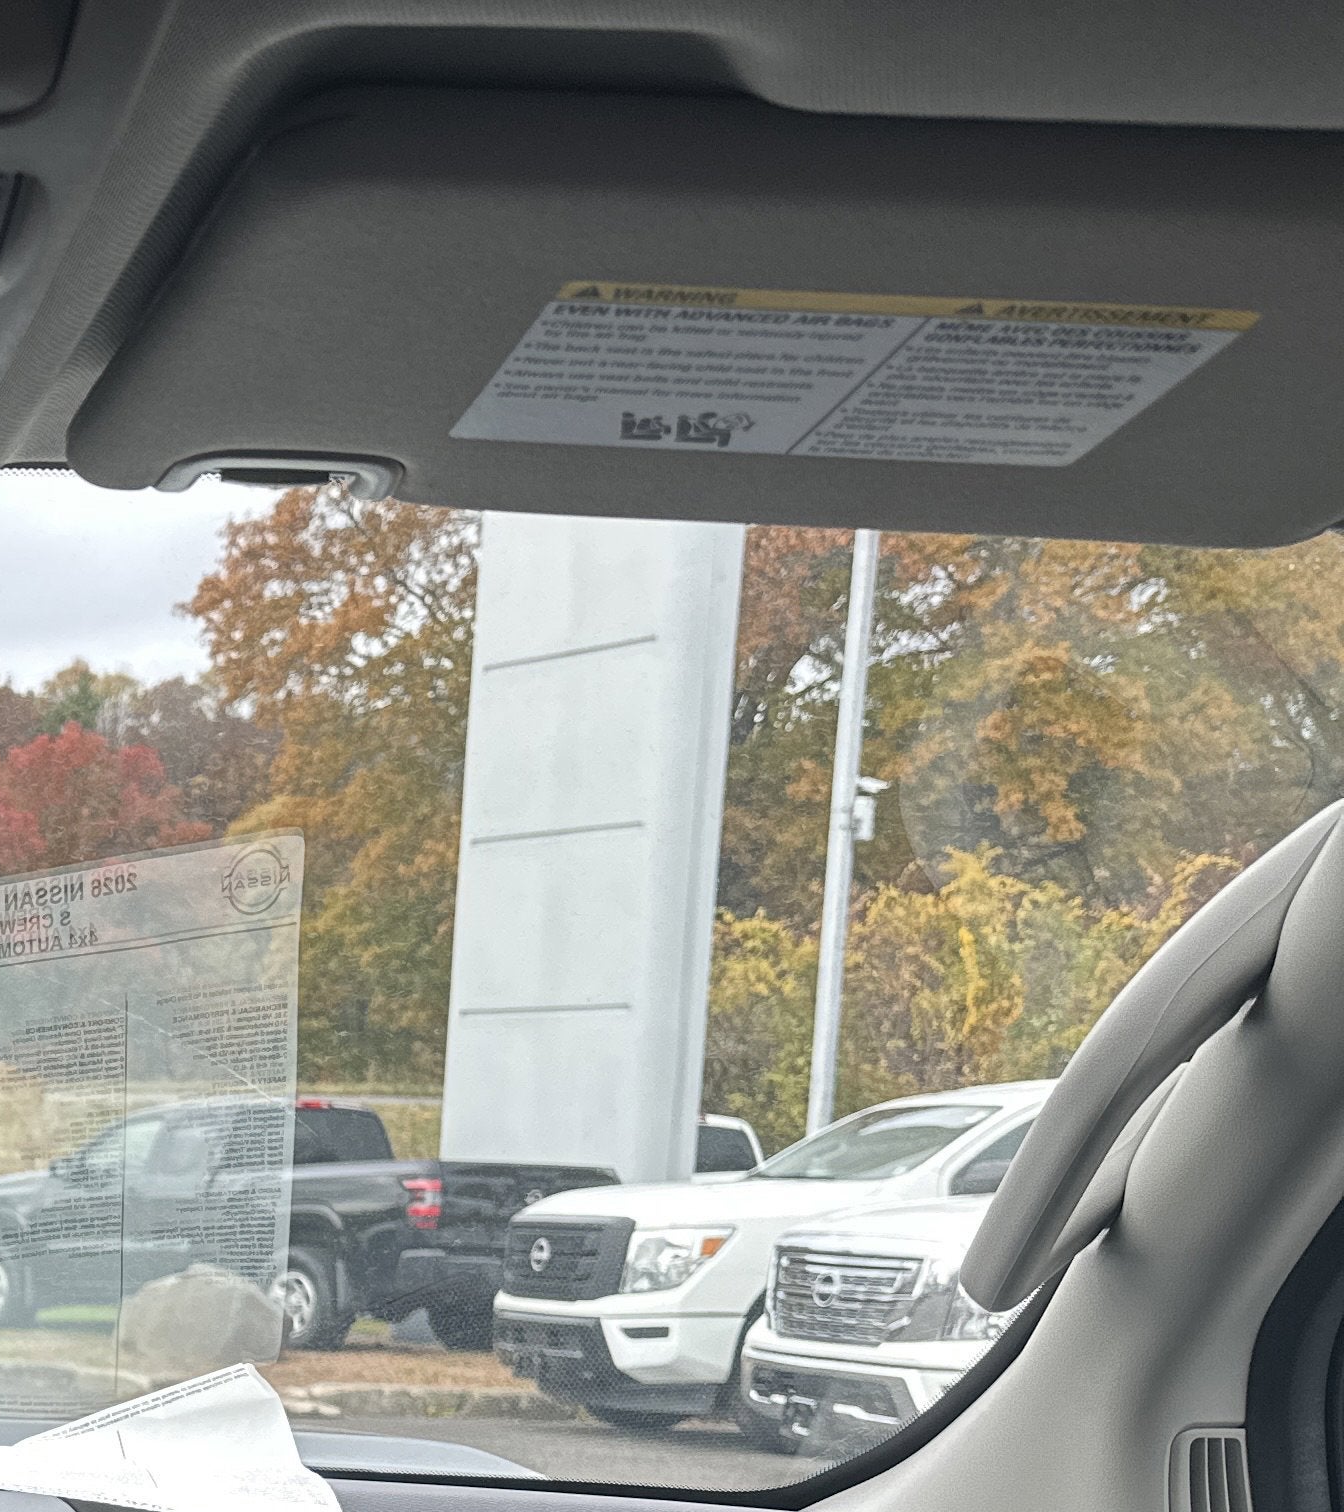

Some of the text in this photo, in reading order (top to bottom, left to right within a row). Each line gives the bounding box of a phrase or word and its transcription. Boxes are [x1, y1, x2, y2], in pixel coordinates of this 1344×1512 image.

[614, 287, 737, 303] WARNING
[553, 304, 897, 329] EVEN WITH ADVANCED AIR BAGS
[1001, 304, 1213, 323] AVERTISSEMENT
